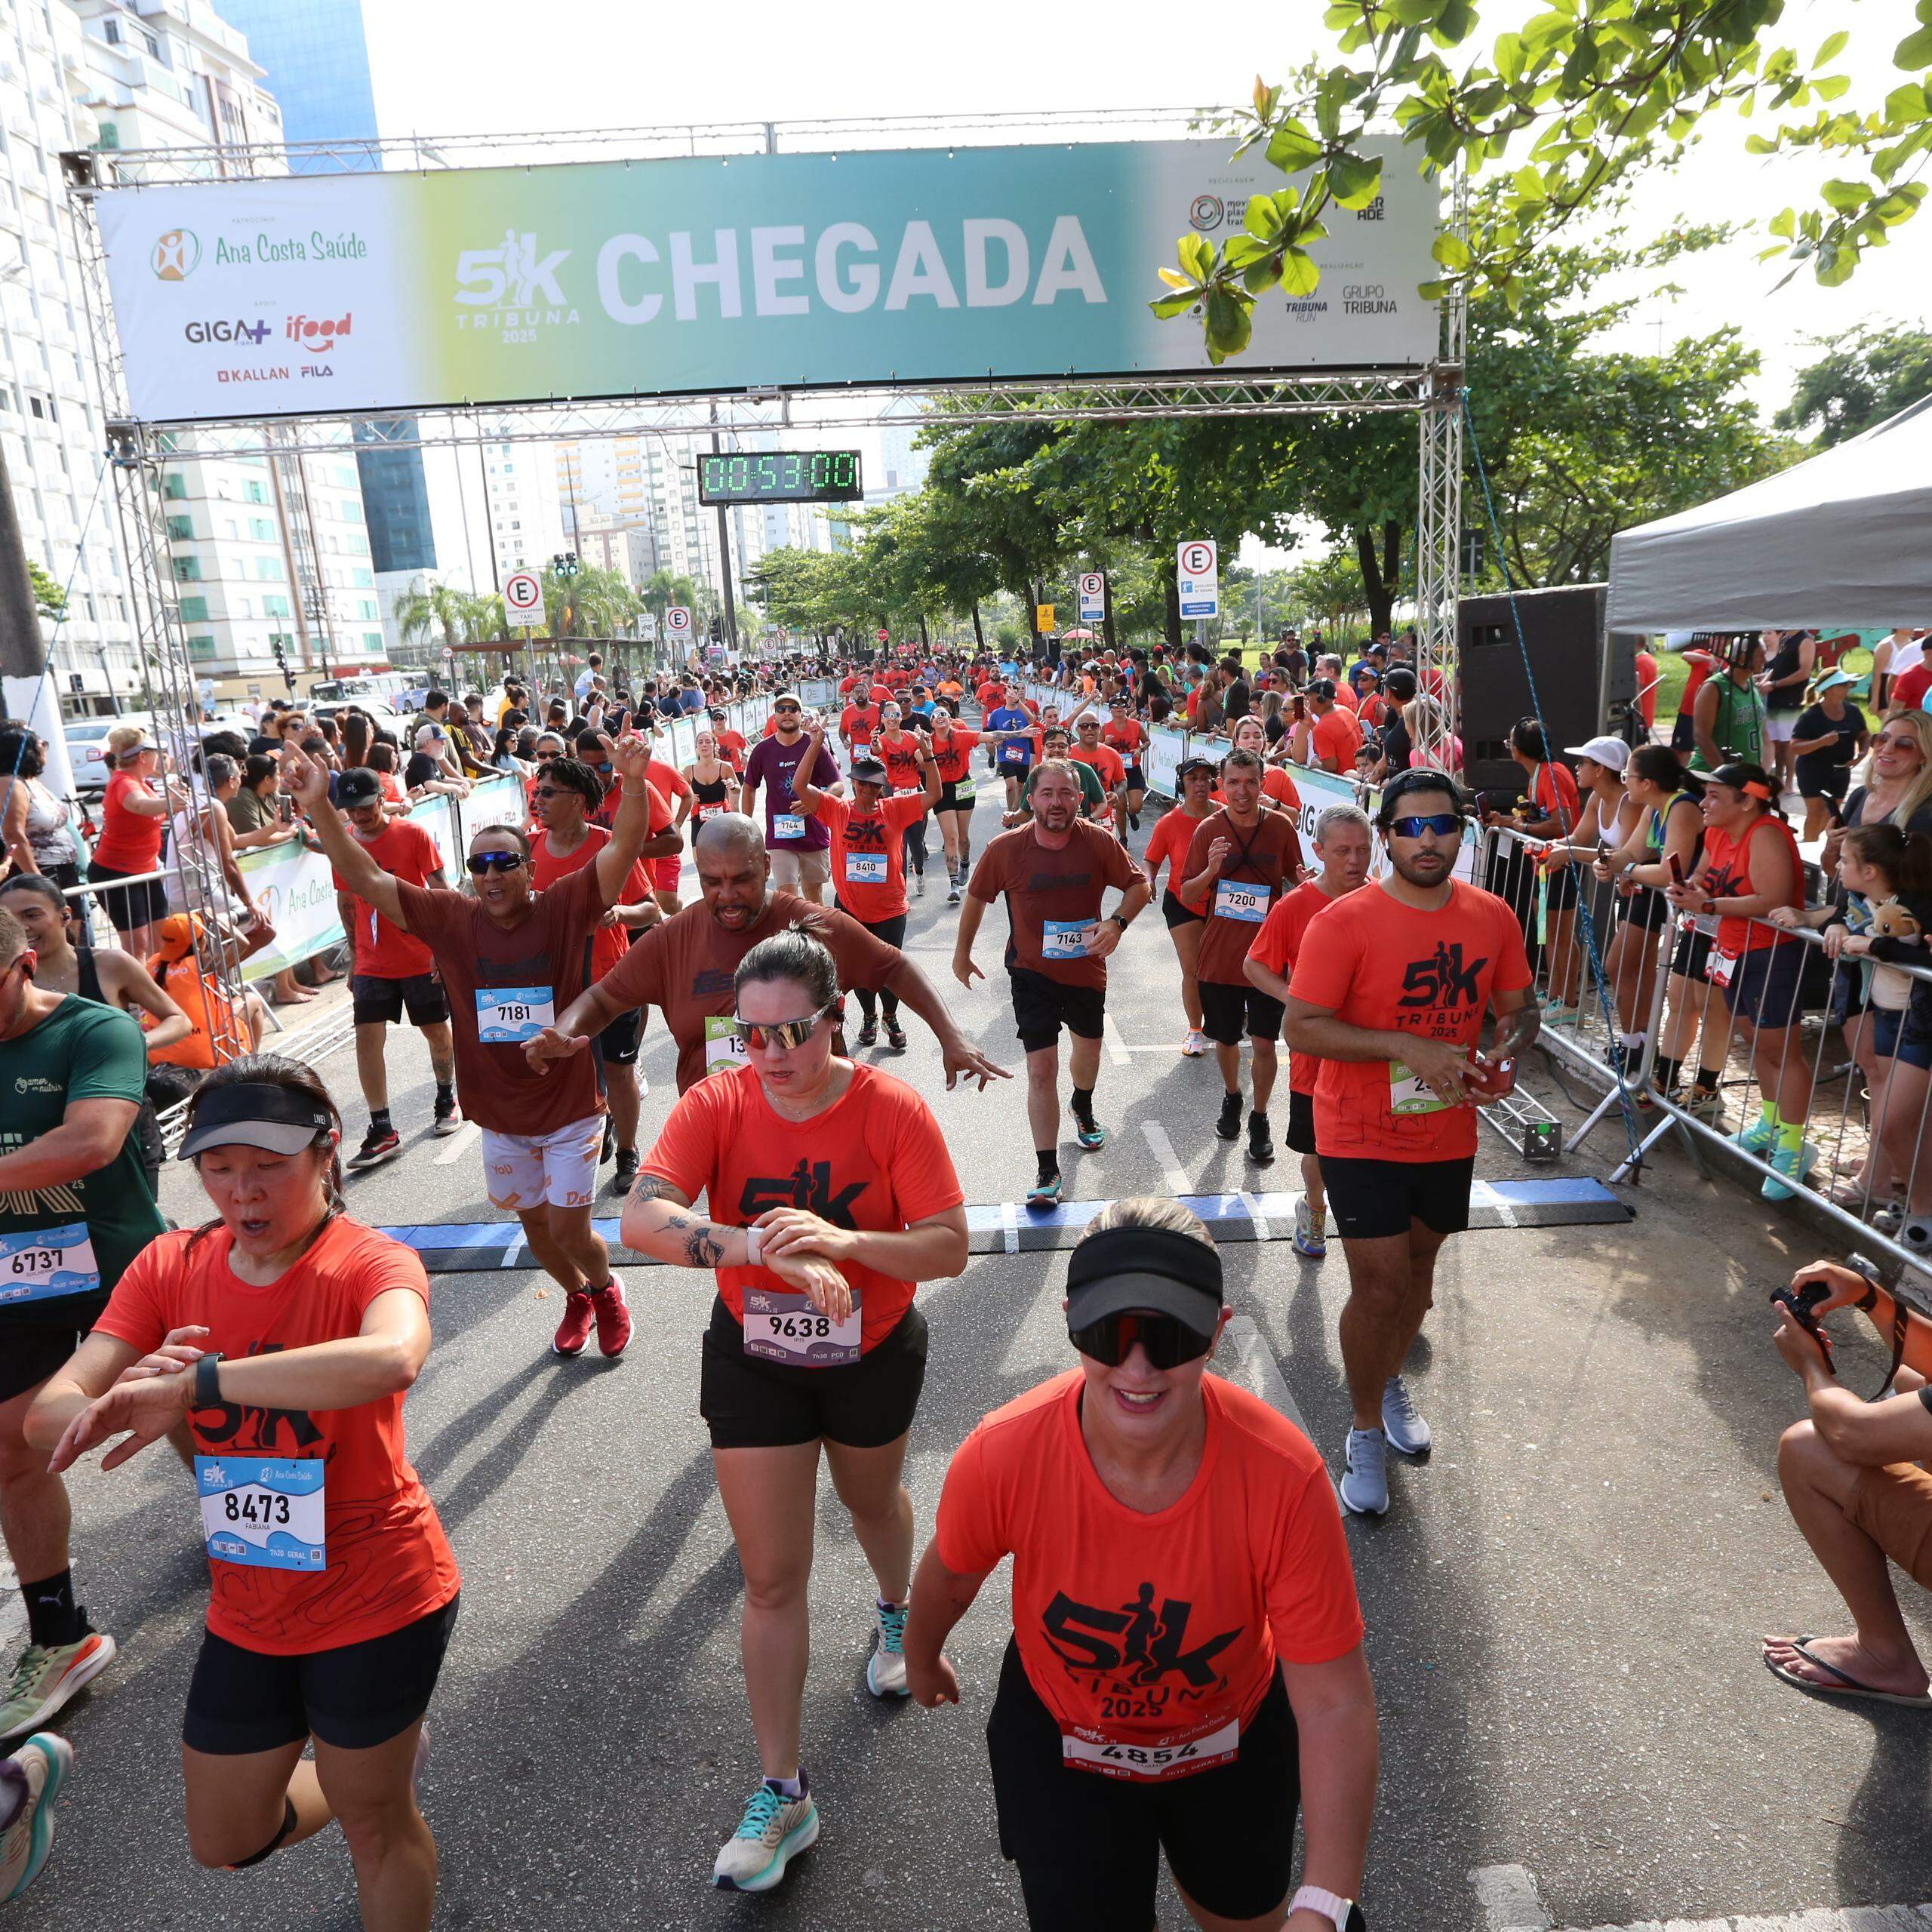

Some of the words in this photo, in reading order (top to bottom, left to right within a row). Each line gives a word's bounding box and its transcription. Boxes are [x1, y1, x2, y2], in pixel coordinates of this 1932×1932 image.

[216, 237, 251, 265] Ana
[257, 233, 306, 263] Costa
[311, 230, 368, 260] Saúde
[596, 215, 1109, 325] CHEGADA
[1343, 285, 1384, 299] GRUPO
[1286, 302, 1327, 312] TRIBUNA
[1343, 300, 1397, 314] TRIBUNA
[455, 309, 580, 330] TRIBUNA
[1295, 312, 1317, 322] RUN
[502, 328, 537, 343] 2025
[232, 367, 290, 382] KALLAN
[300, 365, 334, 377] FILA
[705, 453, 854, 492] 00:53:00
[1192, 549, 1203, 568] E
[516, 581, 529, 601] E
[1088, 578, 1096, 590] E
[674, 613, 682, 625] E
[856, 863, 876, 872] 8410
[289, 888, 306, 915] Ana
[309, 878, 332, 906] Costa
[1229, 893, 1256, 906] 7200
[1057, 933, 1082, 945] 7143
[497, 1005, 531, 1021] 7181
[1431, 1026, 1457, 1038] 2025
[71, 1179, 85, 1189] 25
[11, 1249, 63, 1275] 6737
[769, 1316, 830, 1338] 9638
[224, 1493, 290, 1524] 8473
[245, 1522, 271, 1531] FABIANA
[287, 1549, 307, 1560] GERAL
[1100, 1697, 1163, 1719] 2025
[1101, 1741, 1198, 1764] 4854
